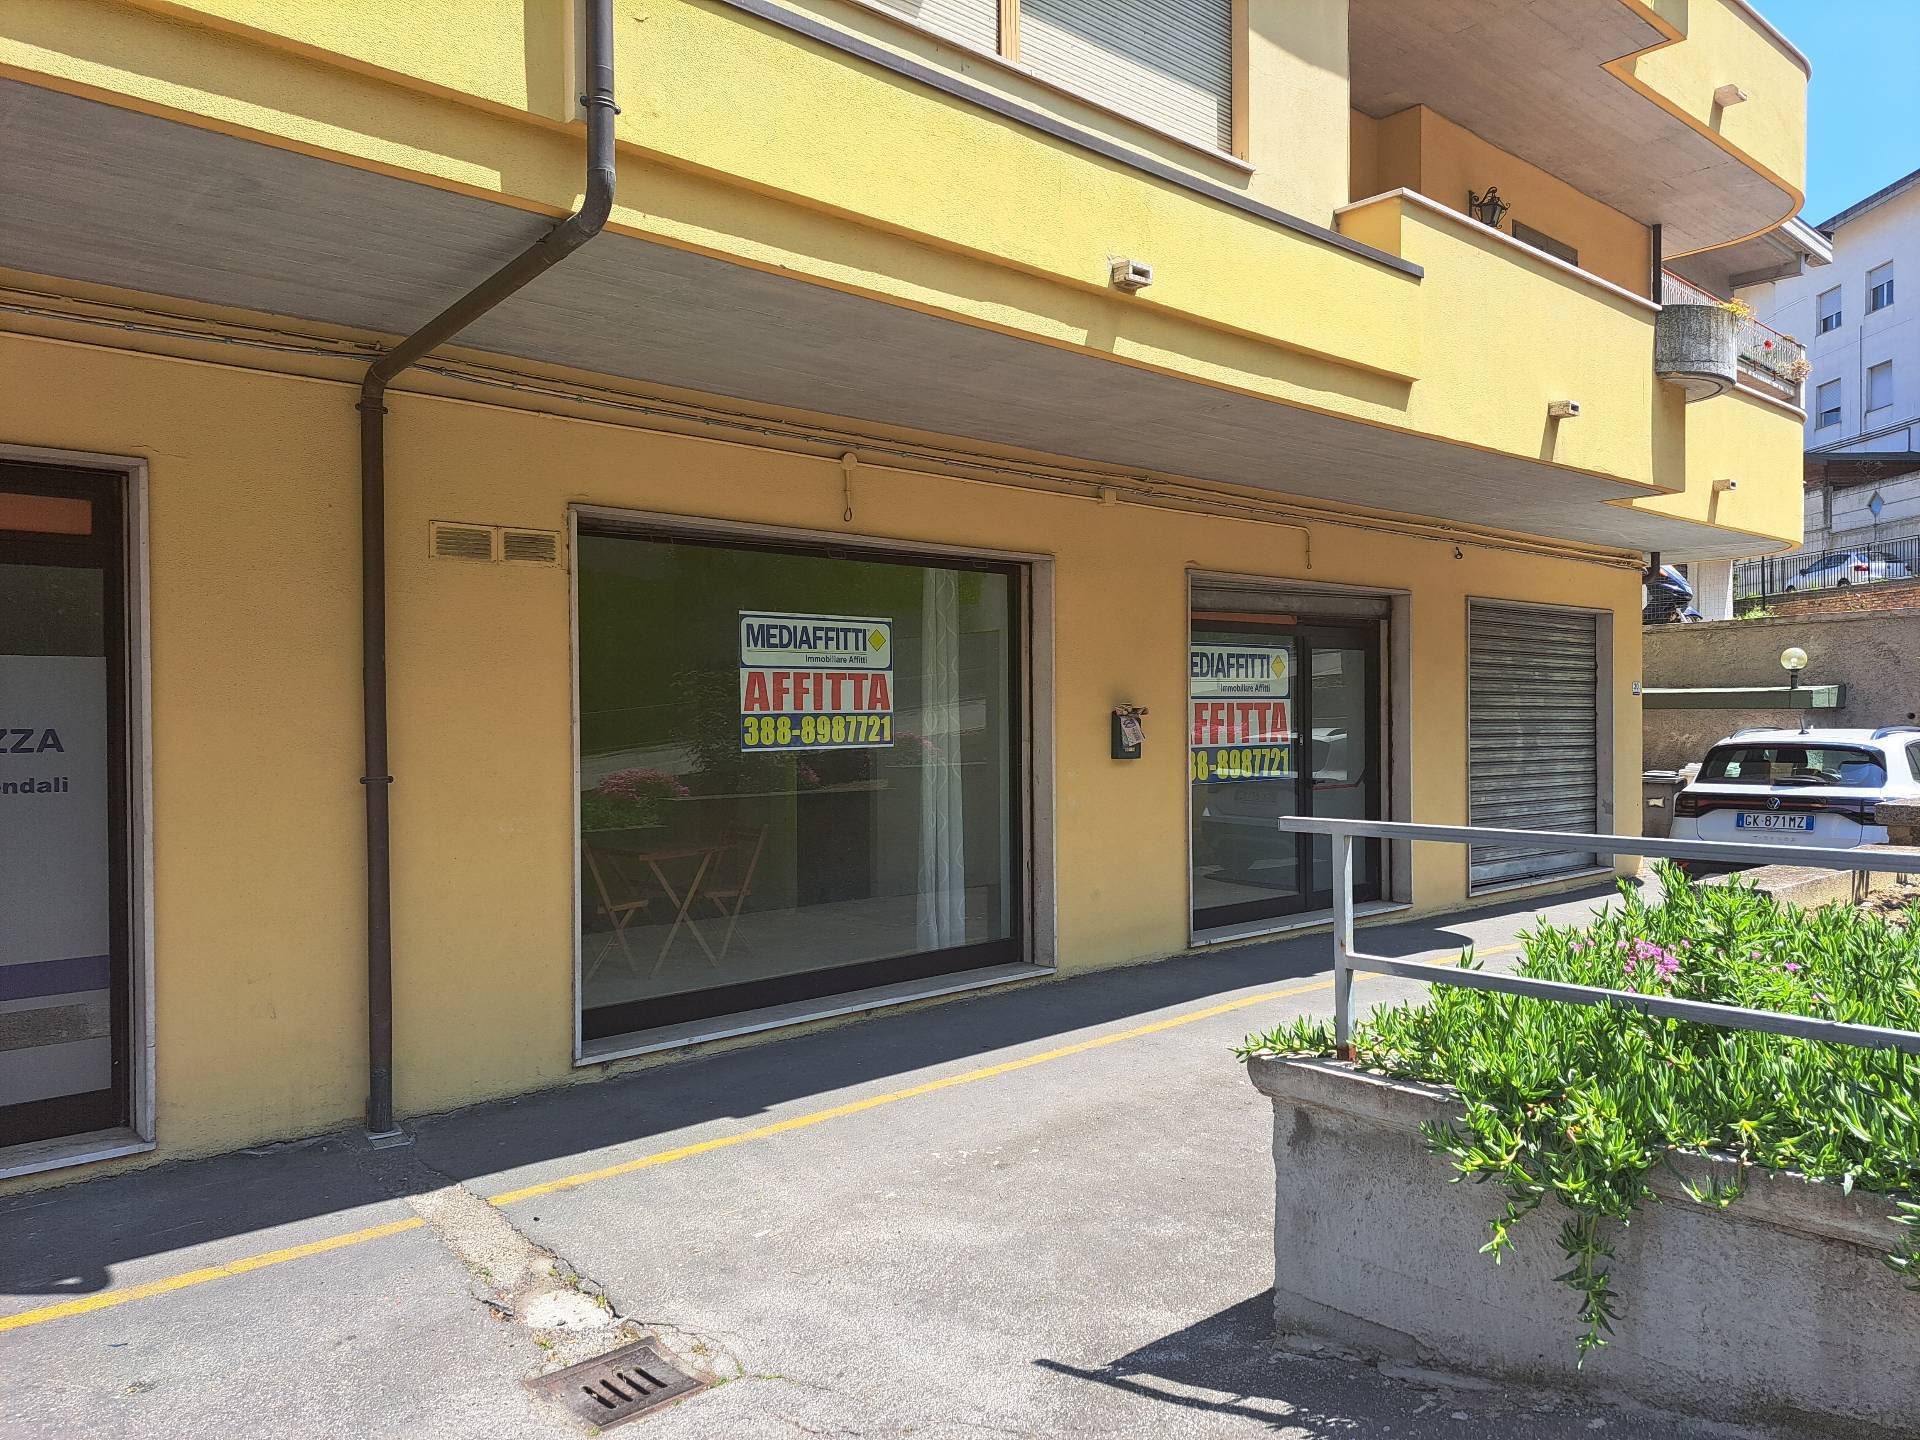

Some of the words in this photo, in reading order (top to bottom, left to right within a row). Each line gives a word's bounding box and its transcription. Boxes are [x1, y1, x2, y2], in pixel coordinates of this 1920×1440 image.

[745, 623, 867, 651] MEDIAFFITTI
[805, 654, 847, 664] Immobiliare
[849, 655, 868, 664] Affitti
[1191, 651, 1271, 679] EDIAFFITTI
[743, 671, 890, 712] AFFITTA
[743, 715, 891, 746] 388-8987721
[1191, 702, 1289, 745] FFITTA
[0, 776, 69, 795] ndali
